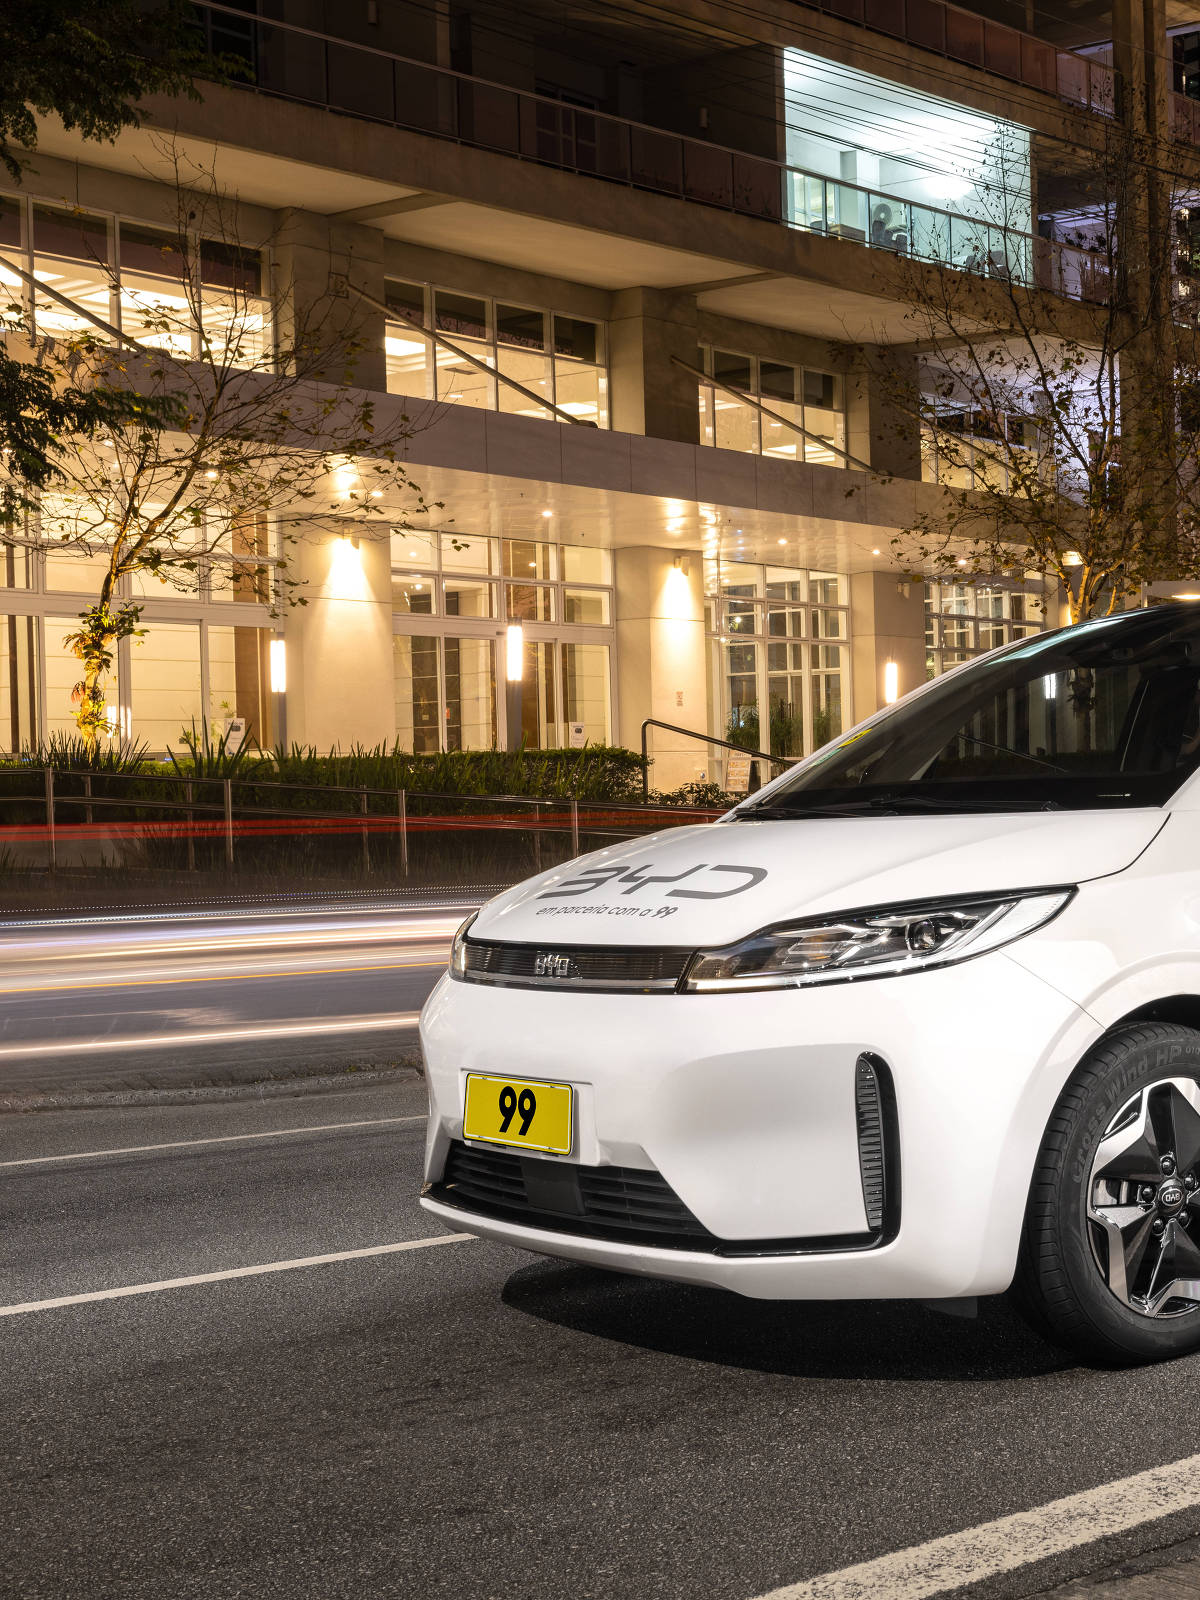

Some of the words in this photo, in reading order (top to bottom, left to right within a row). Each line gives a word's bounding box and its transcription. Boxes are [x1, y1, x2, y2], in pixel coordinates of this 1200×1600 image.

[536, 864, 768, 900] BYD
[535, 906, 558, 916] em
[552, 904, 609, 917] parceria
[608, 906, 640, 916] com
[639, 908, 653, 917] a
[651, 906, 679, 919] 99
[534, 954, 570, 976] BYD
[1156, 1044, 1183, 1071] HP
[499, 1086, 537, 1137] 99
